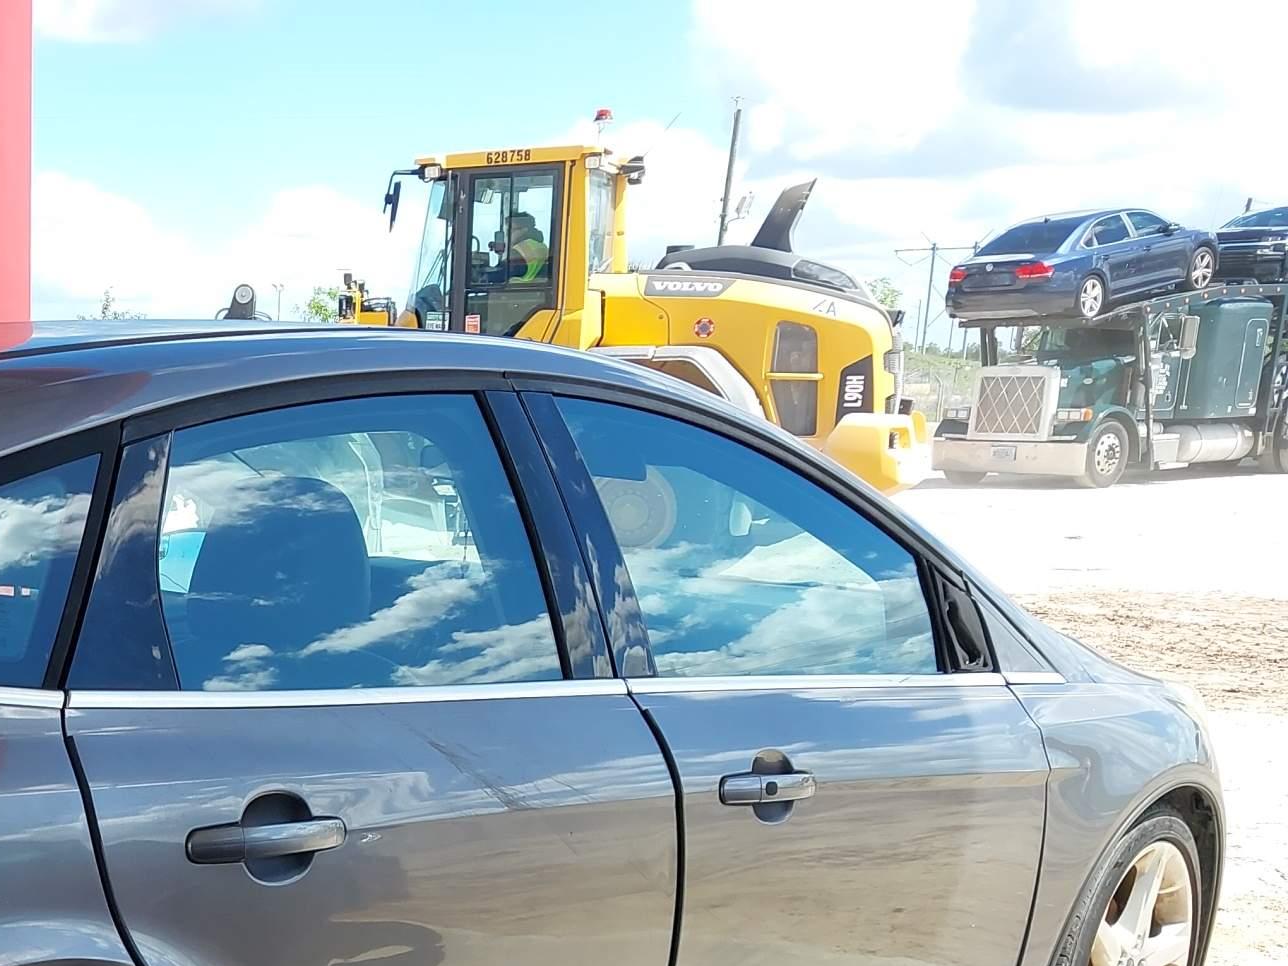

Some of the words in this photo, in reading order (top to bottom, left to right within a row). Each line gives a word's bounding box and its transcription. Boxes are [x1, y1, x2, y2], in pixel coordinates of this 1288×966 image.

[486, 149, 531, 165] 628758
[652, 280, 723, 292] VOLVO
[842, 375, 865, 408] L90H
